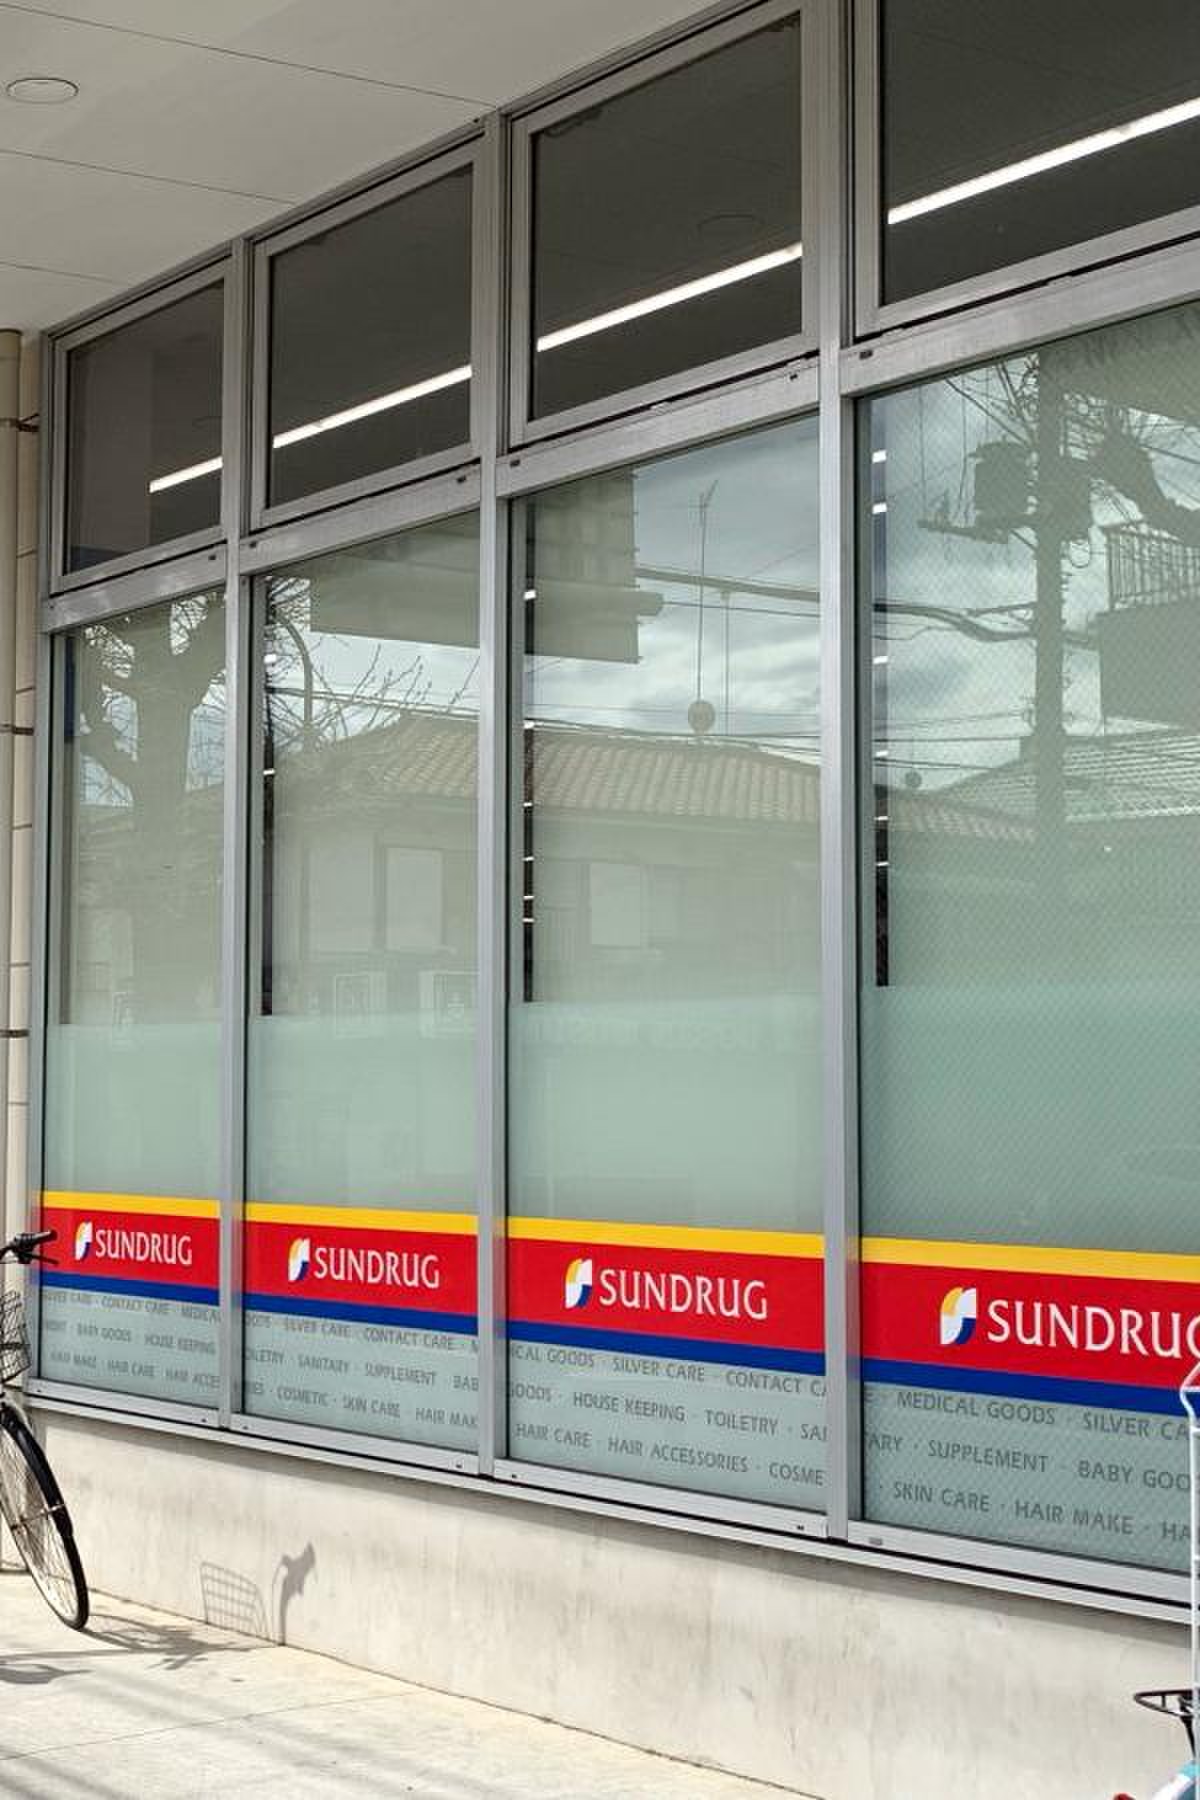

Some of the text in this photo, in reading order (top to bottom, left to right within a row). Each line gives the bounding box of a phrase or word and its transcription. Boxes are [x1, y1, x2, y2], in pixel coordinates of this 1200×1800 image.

[95, 1229, 193, 1266] SUNDRUG
[314, 1247, 440, 1289] SUNDRUG
[599, 1268, 768, 1320] SUNDRUG
[365, 1327, 419, 1346] CONTACT
[422, 1336, 456, 1351] CARE
[365, 1362, 437, 1387] SUPPLEMENT
[547, 1348, 595, 1368] GOODS
[613, 1356, 660, 1376] SILVER
[666, 1362, 705, 1382] CARE
[726, 1370, 801, 1394] CONTACT
[371, 1400, 401, 1418] CARE
[415, 1407, 446, 1425] HAIR
[573, 1391, 619, 1413] HOUSE
[624, 1398, 685, 1422] KEEPING
[706, 1409, 779, 1436] TOILETRY
[897, 1391, 979, 1417] MEDICAL
[987, 1401, 1057, 1425] GOODS
[1083, 1411, 1150, 1438] SILVER
[516, 1423, 548, 1440] HAIR
[554, 1428, 592, 1448] CARE
[607, 1437, 643, 1457] HAIR
[652, 1444, 749, 1473] ACCESSORIES
[928, 1439, 1049, 1473] SUPPLEMENT
[1078, 1459, 1133, 1484] BABY
[895, 1481, 933, 1502] SKIN
[943, 1487, 990, 1513] CARE
[1015, 1500, 1063, 1522] HAIR
[1073, 1508, 1134, 1535] MAKE
